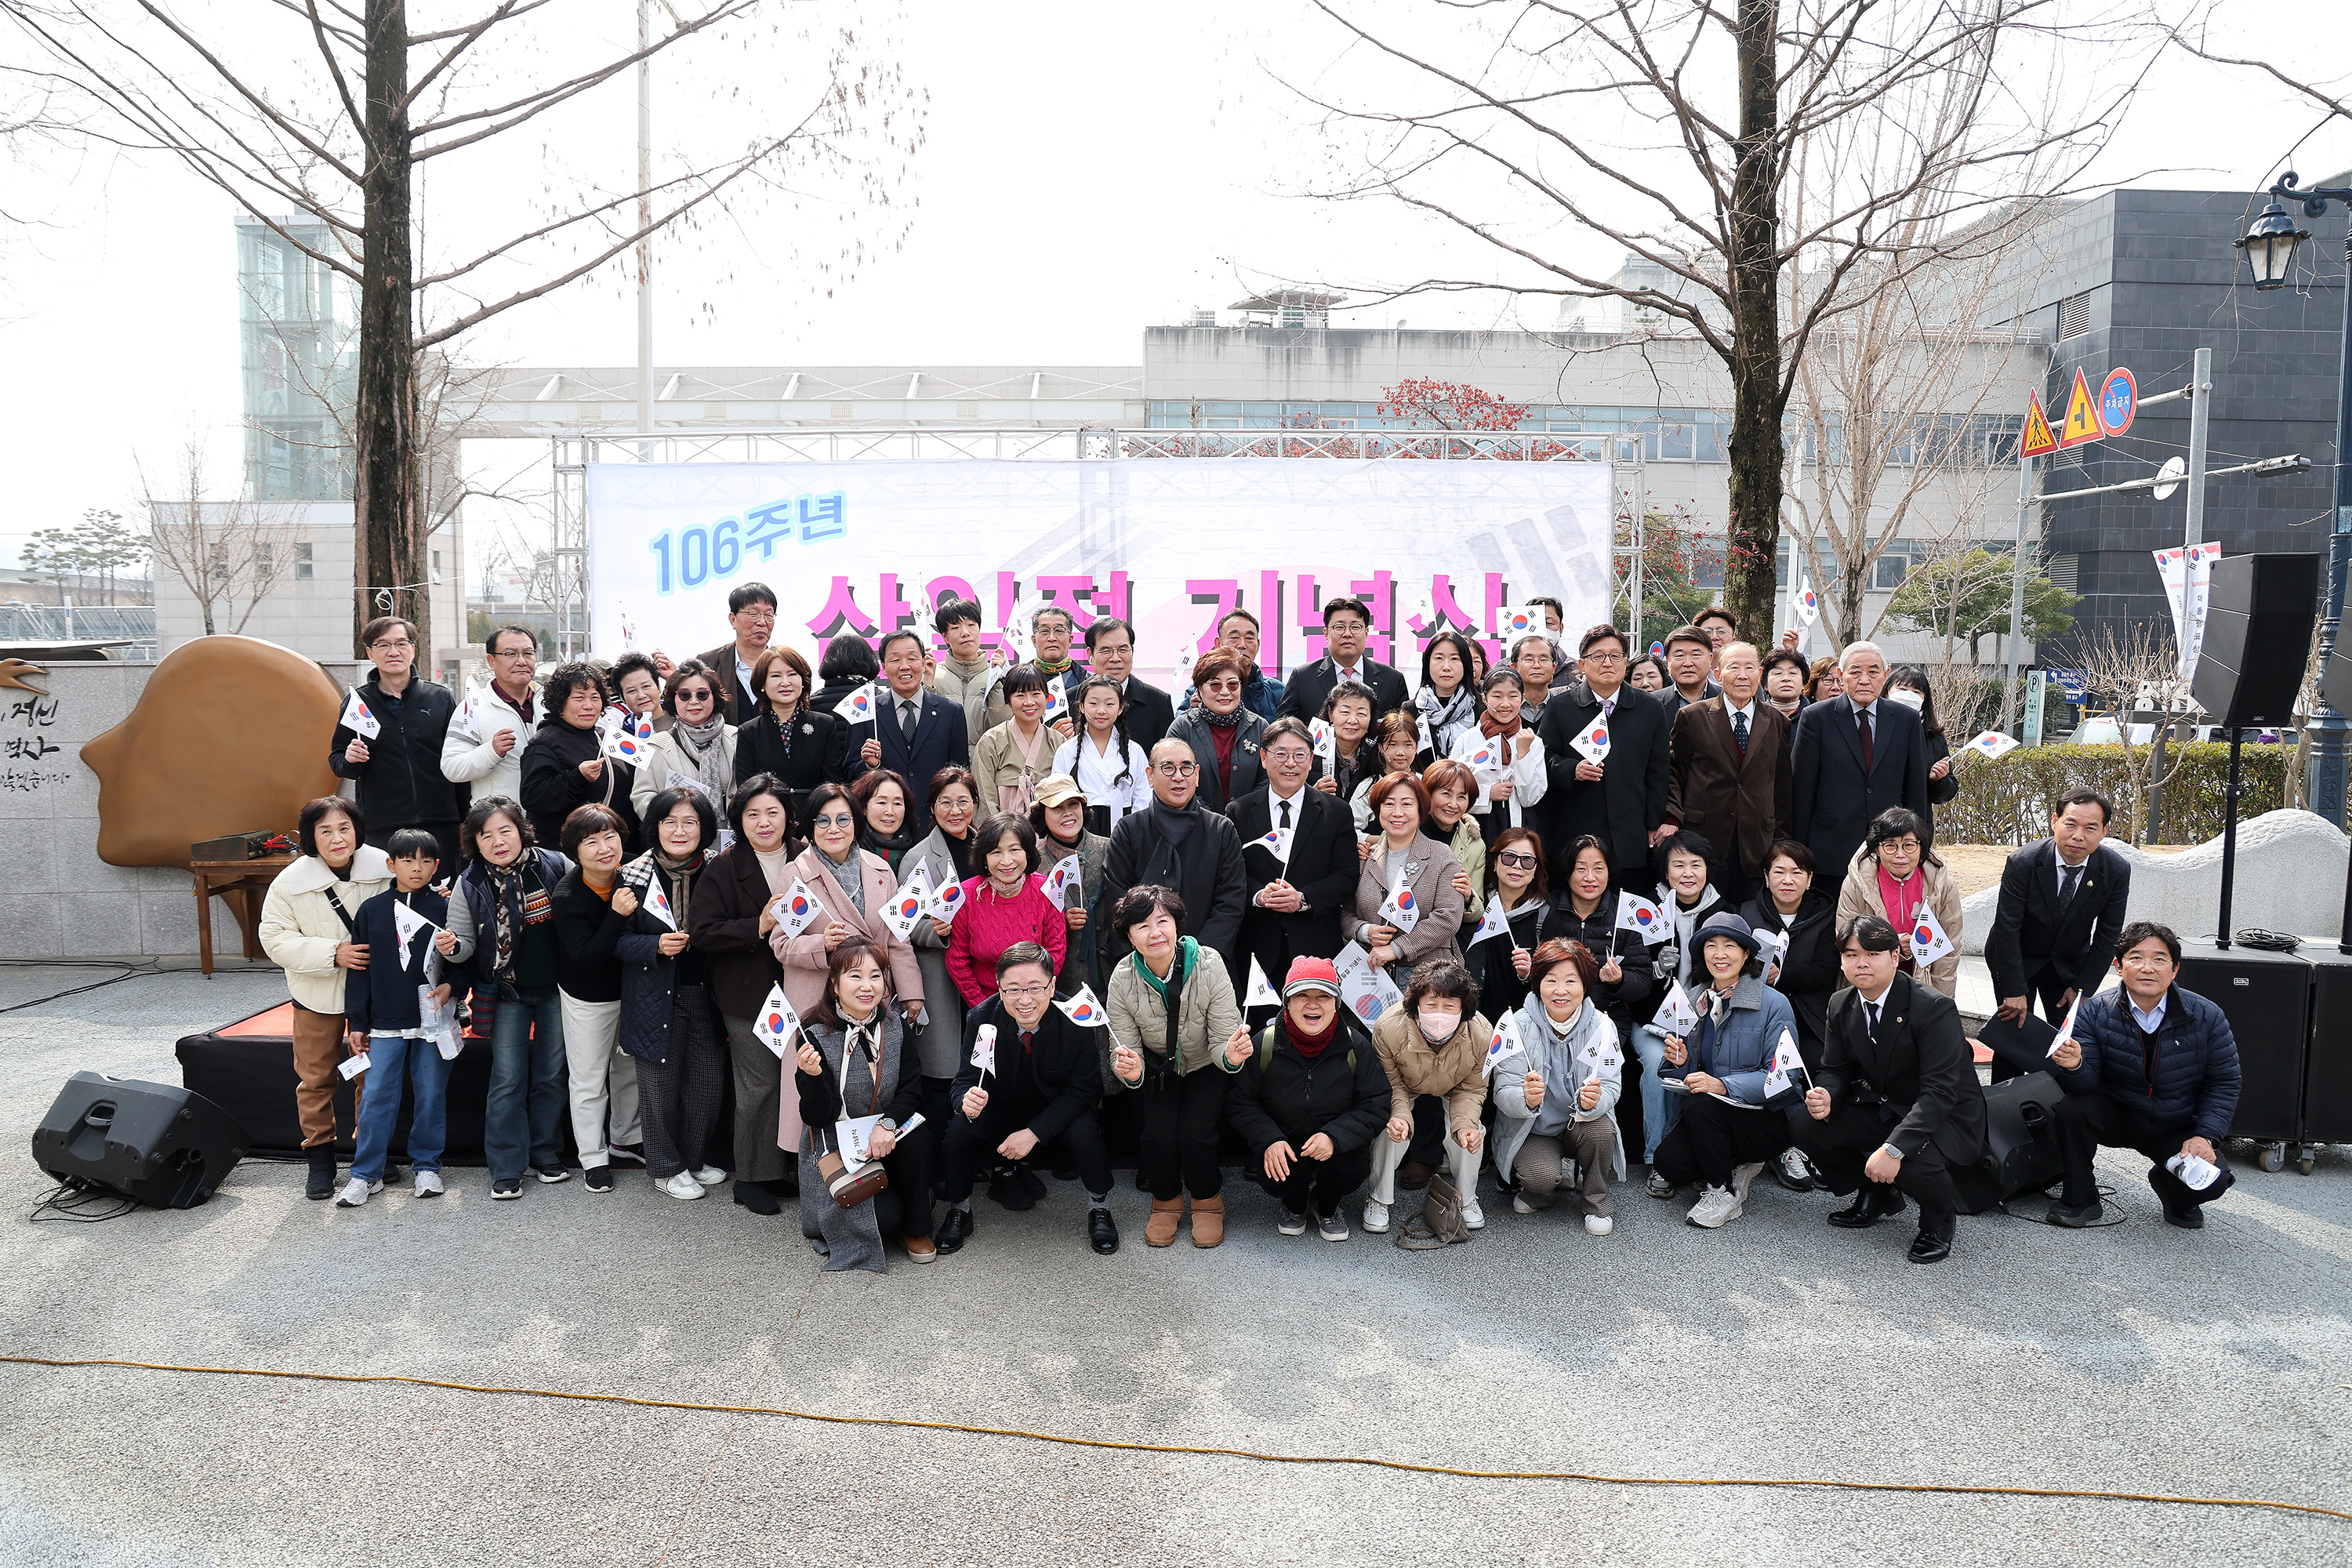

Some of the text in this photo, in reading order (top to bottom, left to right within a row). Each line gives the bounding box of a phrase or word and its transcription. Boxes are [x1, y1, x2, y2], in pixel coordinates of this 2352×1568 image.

[2105, 394, 2130, 410] 주차금지
[652, 493, 844, 593] 106주년
[10, 695, 59, 728] 정신
[5, 735, 60, 760] 역사
